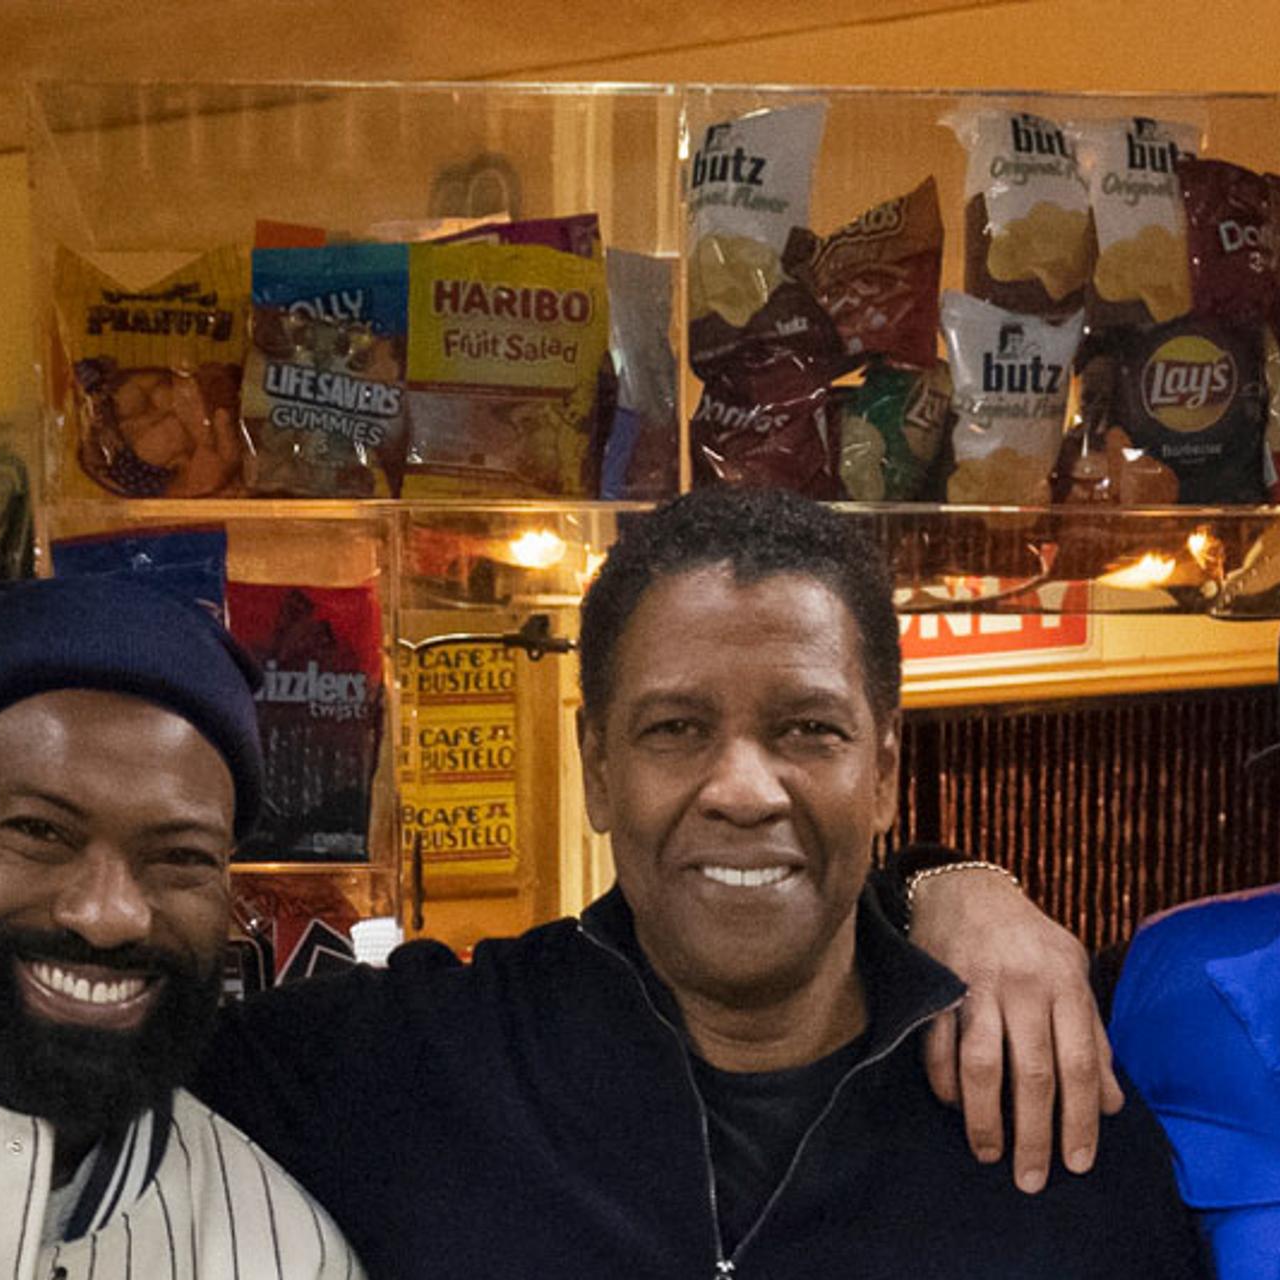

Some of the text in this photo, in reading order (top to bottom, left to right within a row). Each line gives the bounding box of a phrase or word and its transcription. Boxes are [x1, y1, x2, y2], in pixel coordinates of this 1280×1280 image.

[692, 147, 766, 189] butz
[433, 280, 591, 323] HARIBO
[443, 330, 580, 365] Fruit Salad
[265, 364, 403, 417] LIFE SAVERS
[982, 351, 1063, 394] butz
[1149, 353, 1229, 410] Lay's
[272, 405, 386, 448] GUMMIES
[254, 660, 367, 703] izzlers
[420, 670, 515, 693] BUSTELO
[420, 727, 483, 748] CAFE
[421, 747, 514, 771] BUSTELO
[417, 806, 480, 827] CAFE
[420, 825, 512, 850] BUSTELO
